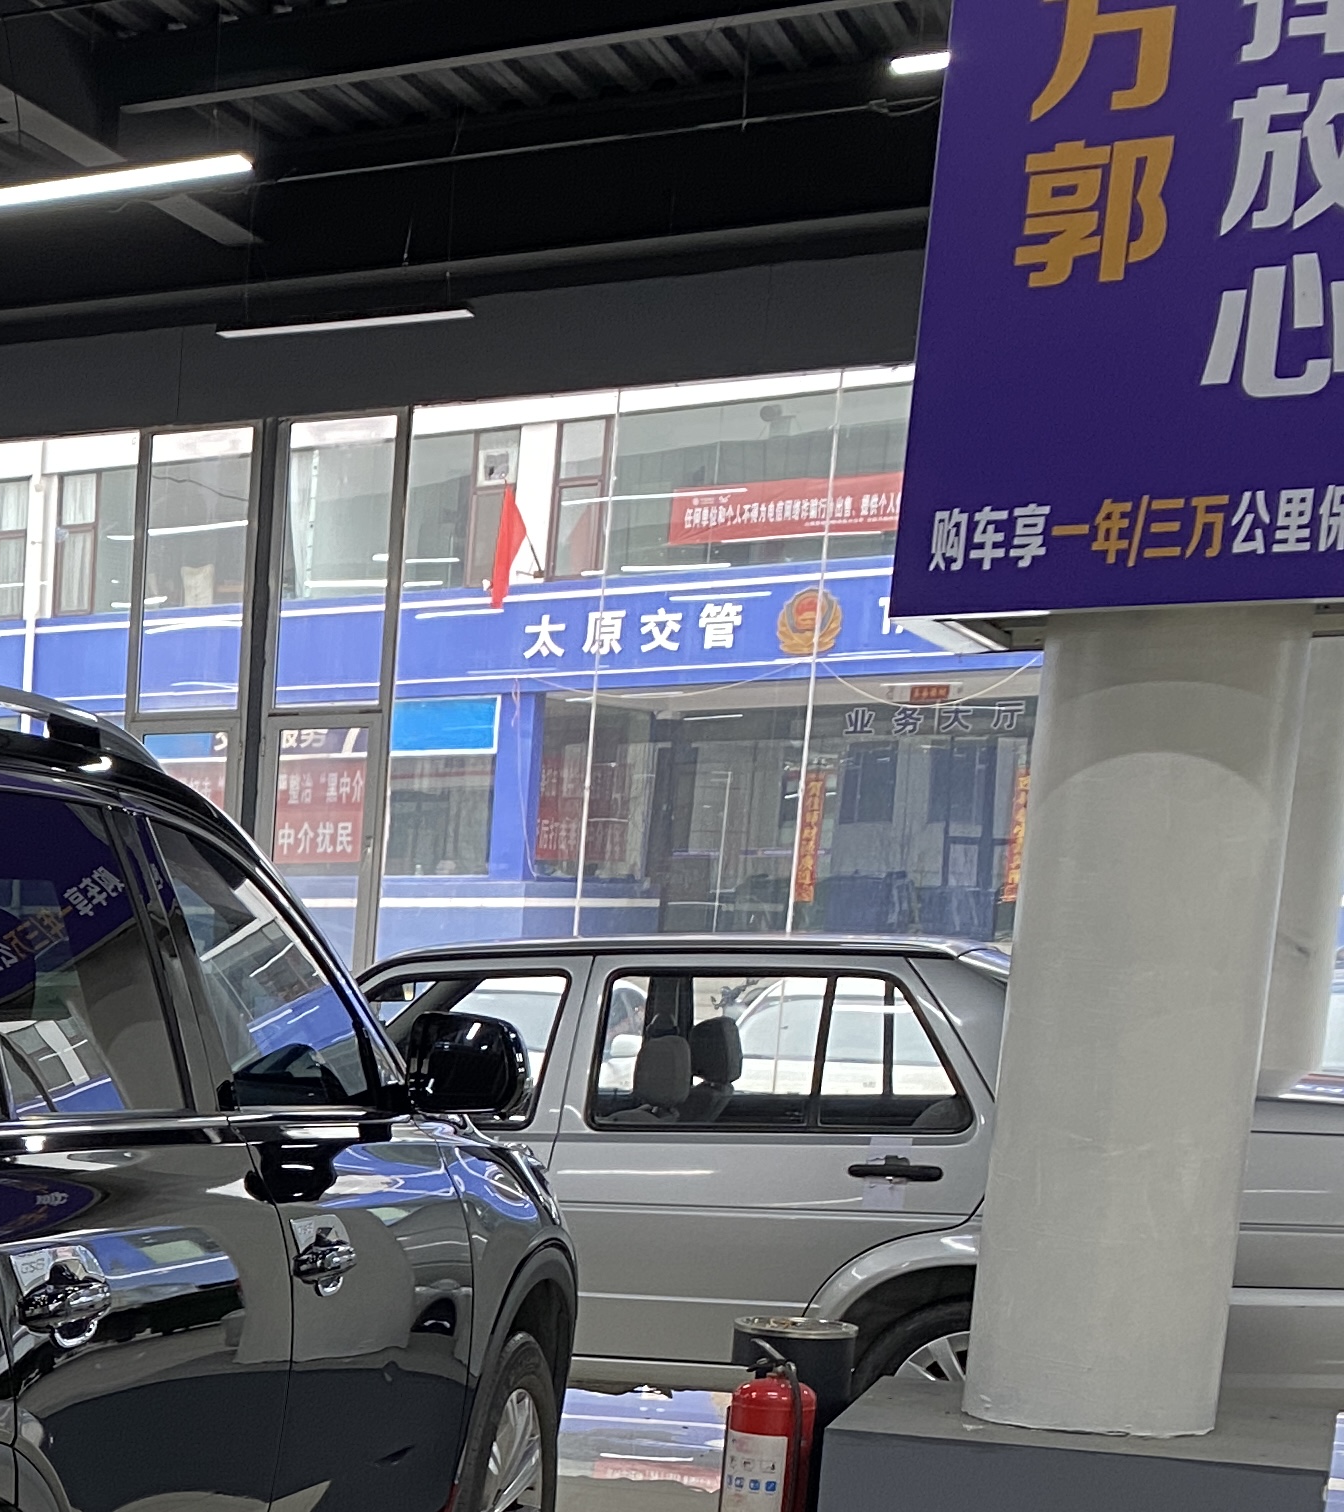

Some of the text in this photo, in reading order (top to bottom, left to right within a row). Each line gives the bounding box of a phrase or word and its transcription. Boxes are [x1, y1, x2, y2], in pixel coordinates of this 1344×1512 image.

[523, 602, 743, 659] 太原交管
[843, 701, 1026, 736] 业务大厅
[279, 821, 353, 854] 中介扰民
